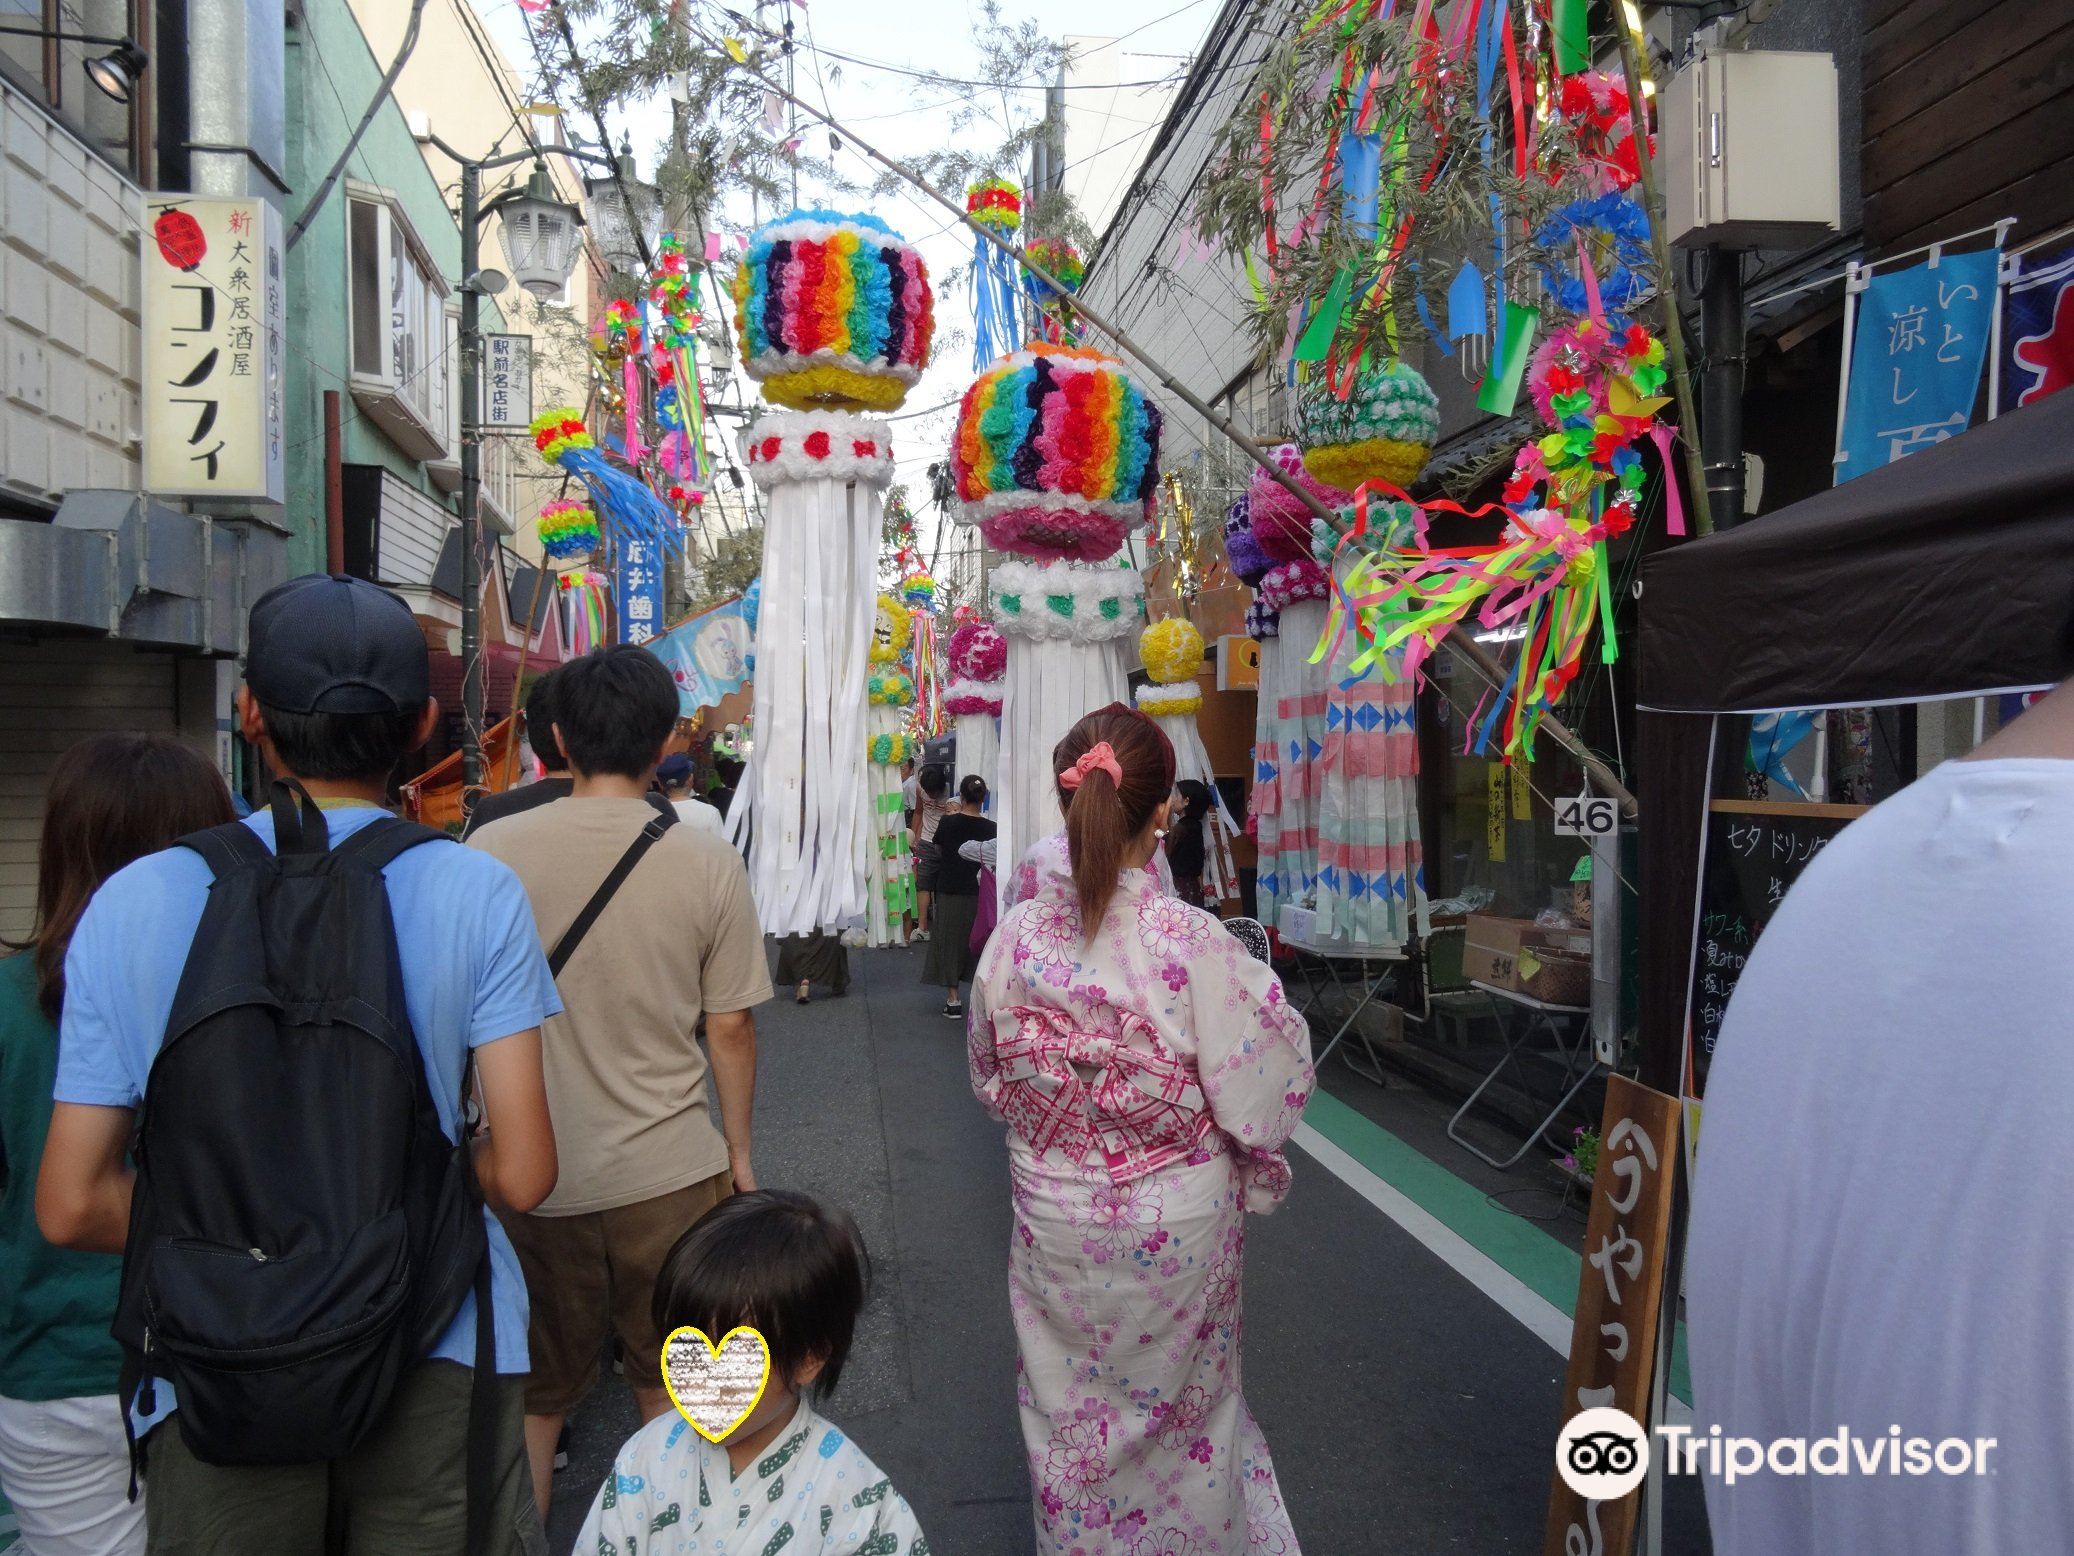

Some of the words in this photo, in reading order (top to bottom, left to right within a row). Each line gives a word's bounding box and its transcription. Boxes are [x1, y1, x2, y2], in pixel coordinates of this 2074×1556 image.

[226, 208, 254, 377] 新大衆居酒屋
[1936, 280, 1979, 363] いと
[168, 284, 226, 481] コンフィ
[492, 339, 510, 422] 駅前名店街
[1887, 304, 1929, 405] 涼し
[1557, 801, 1614, 834] 46
